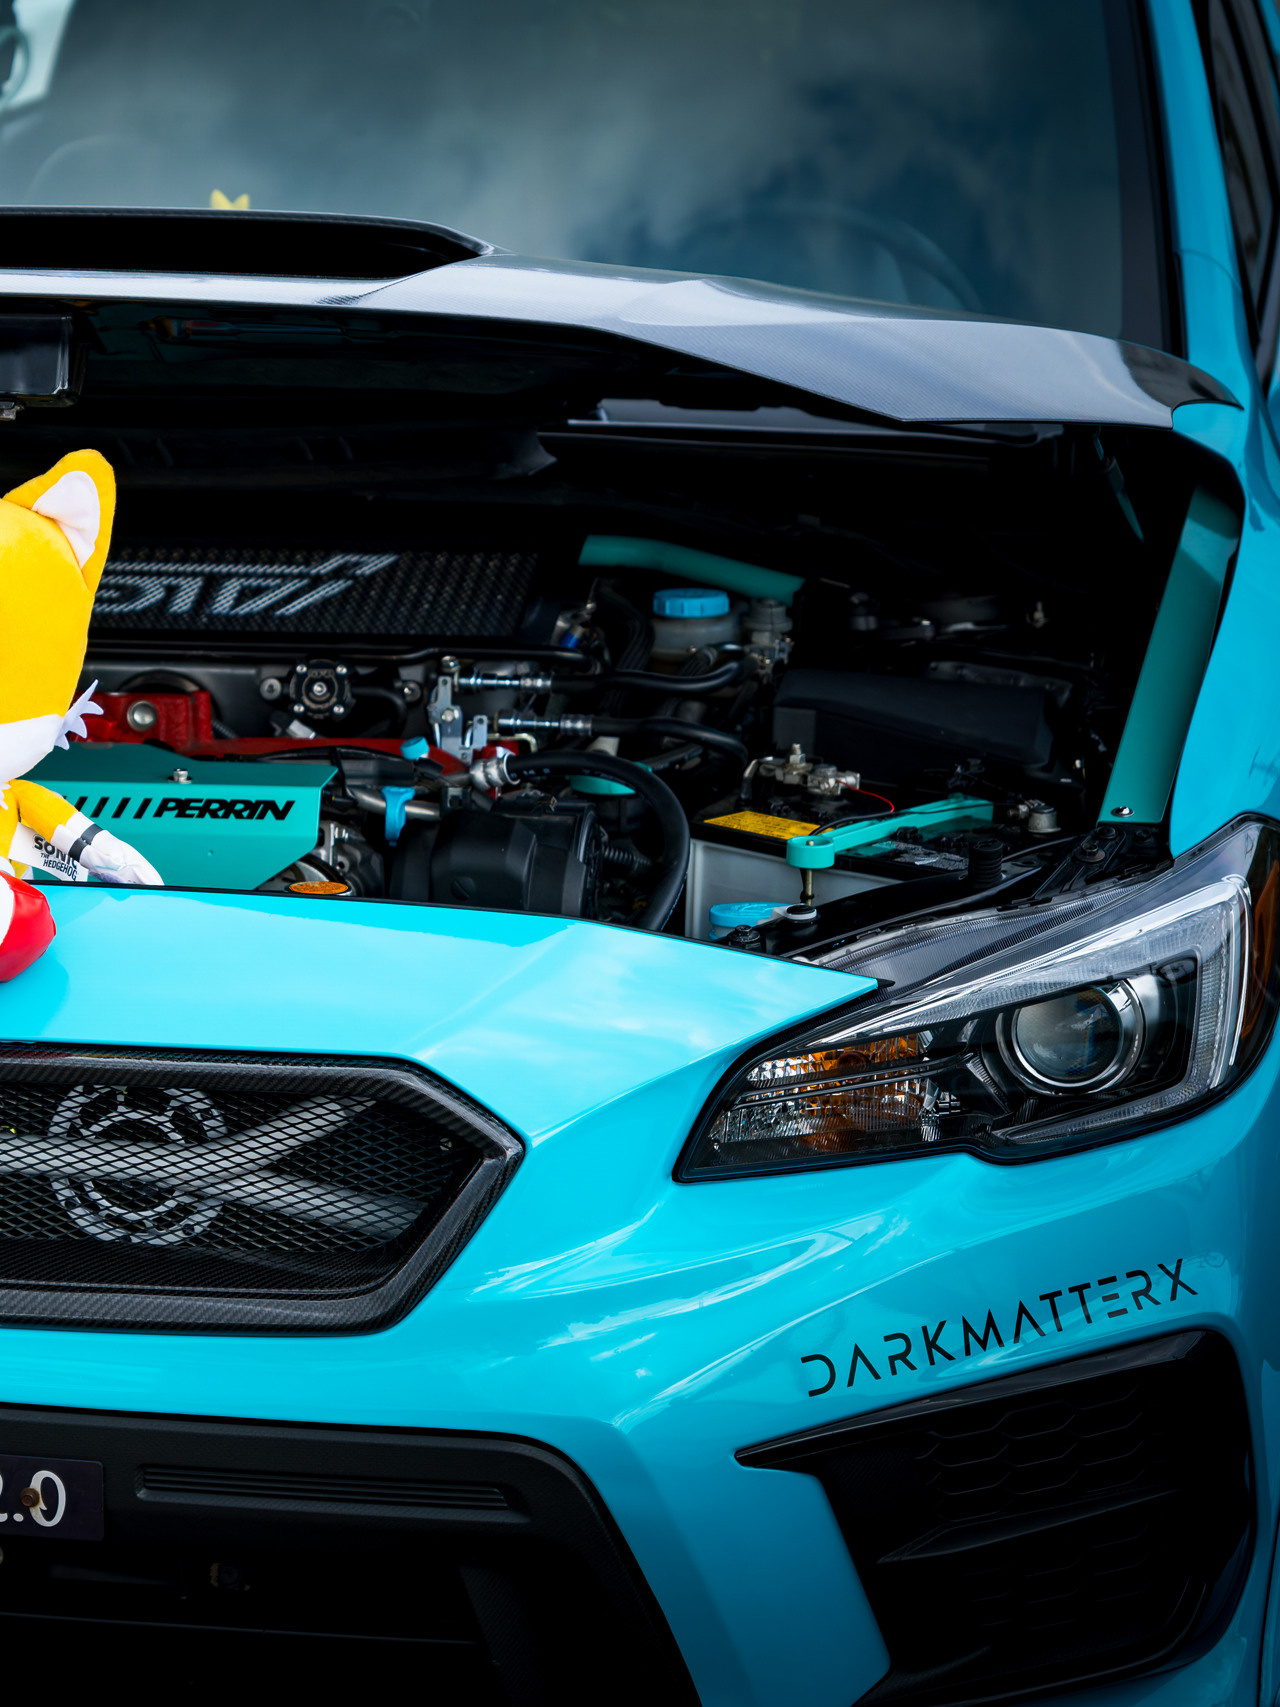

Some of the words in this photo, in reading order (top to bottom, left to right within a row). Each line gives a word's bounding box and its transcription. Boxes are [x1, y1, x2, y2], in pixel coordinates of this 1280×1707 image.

[152, 797, 296, 821] PERRIN
[42, 859, 78, 881] HEDGEHOG
[800, 1258, 1200, 1399] DARKMATTERX
